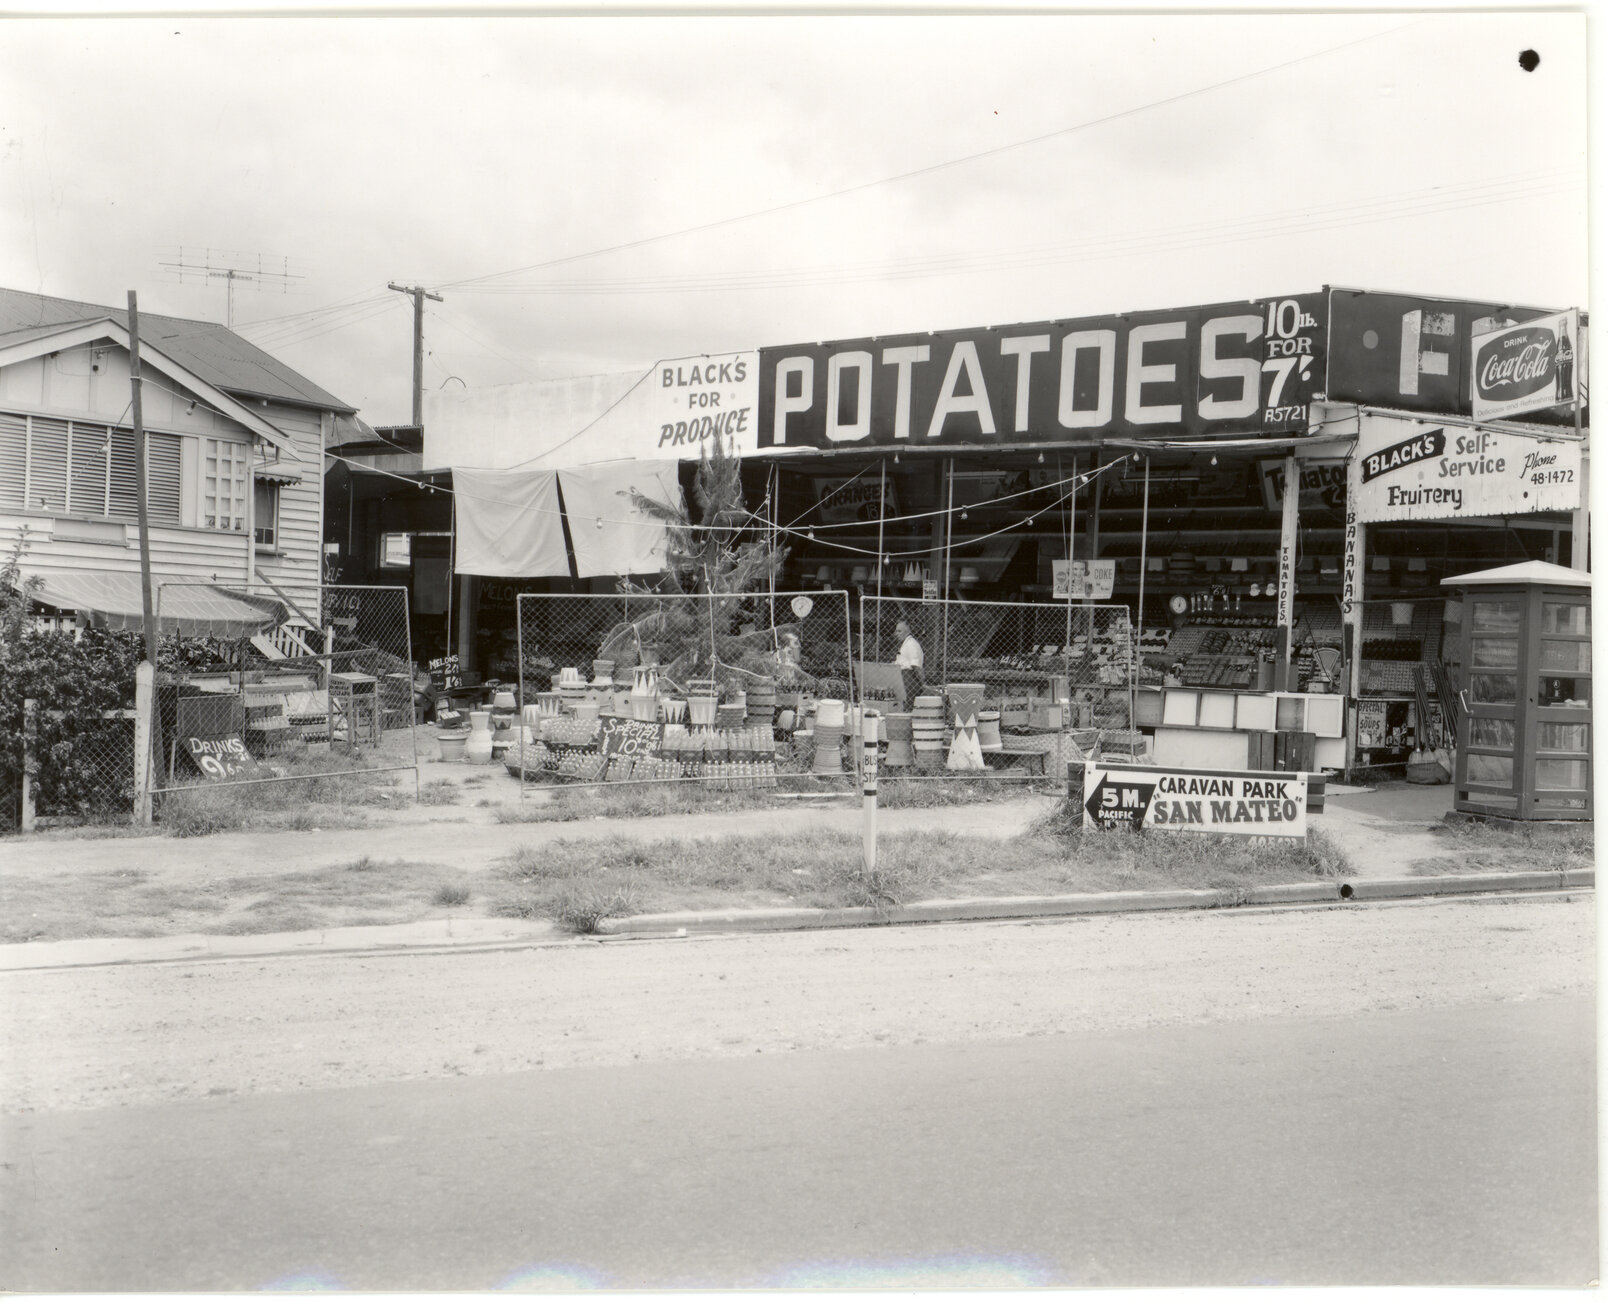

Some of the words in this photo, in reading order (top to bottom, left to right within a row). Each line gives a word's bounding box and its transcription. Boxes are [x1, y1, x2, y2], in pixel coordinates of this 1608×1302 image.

[1267, 336, 1312, 358] FOR
[1503, 335, 1528, 348] DRINK
[662, 355, 747, 388] BLACK'S
[1481, 338, 1552, 390] Coca-Cola
[773, 314, 1263, 445] POTATOES
[688, 391, 721, 409] FOR
[657, 407, 751, 448] PRODUCE
[1456, 433, 1499, 455] Self-
[1367, 435, 1436, 476] BLACK'S
[1438, 455, 1506, 478] Service
[1519, 451, 1557, 479] Phone
[1387, 484, 1463, 509] Fruitery
[1094, 568, 1112, 579] COKE
[1344, 512, 1357, 613] BANANAS
[429, 654, 459, 670] MELONS
[603, 718, 660, 739] SPECIAL
[189, 737, 245, 754] DRINKS
[1101, 788, 1118, 808] 5
[1158, 776, 1234, 797] CARAVAN
[1242, 781, 1289, 800] PARK
[1098, 809, 1134, 820] PACIFIC
